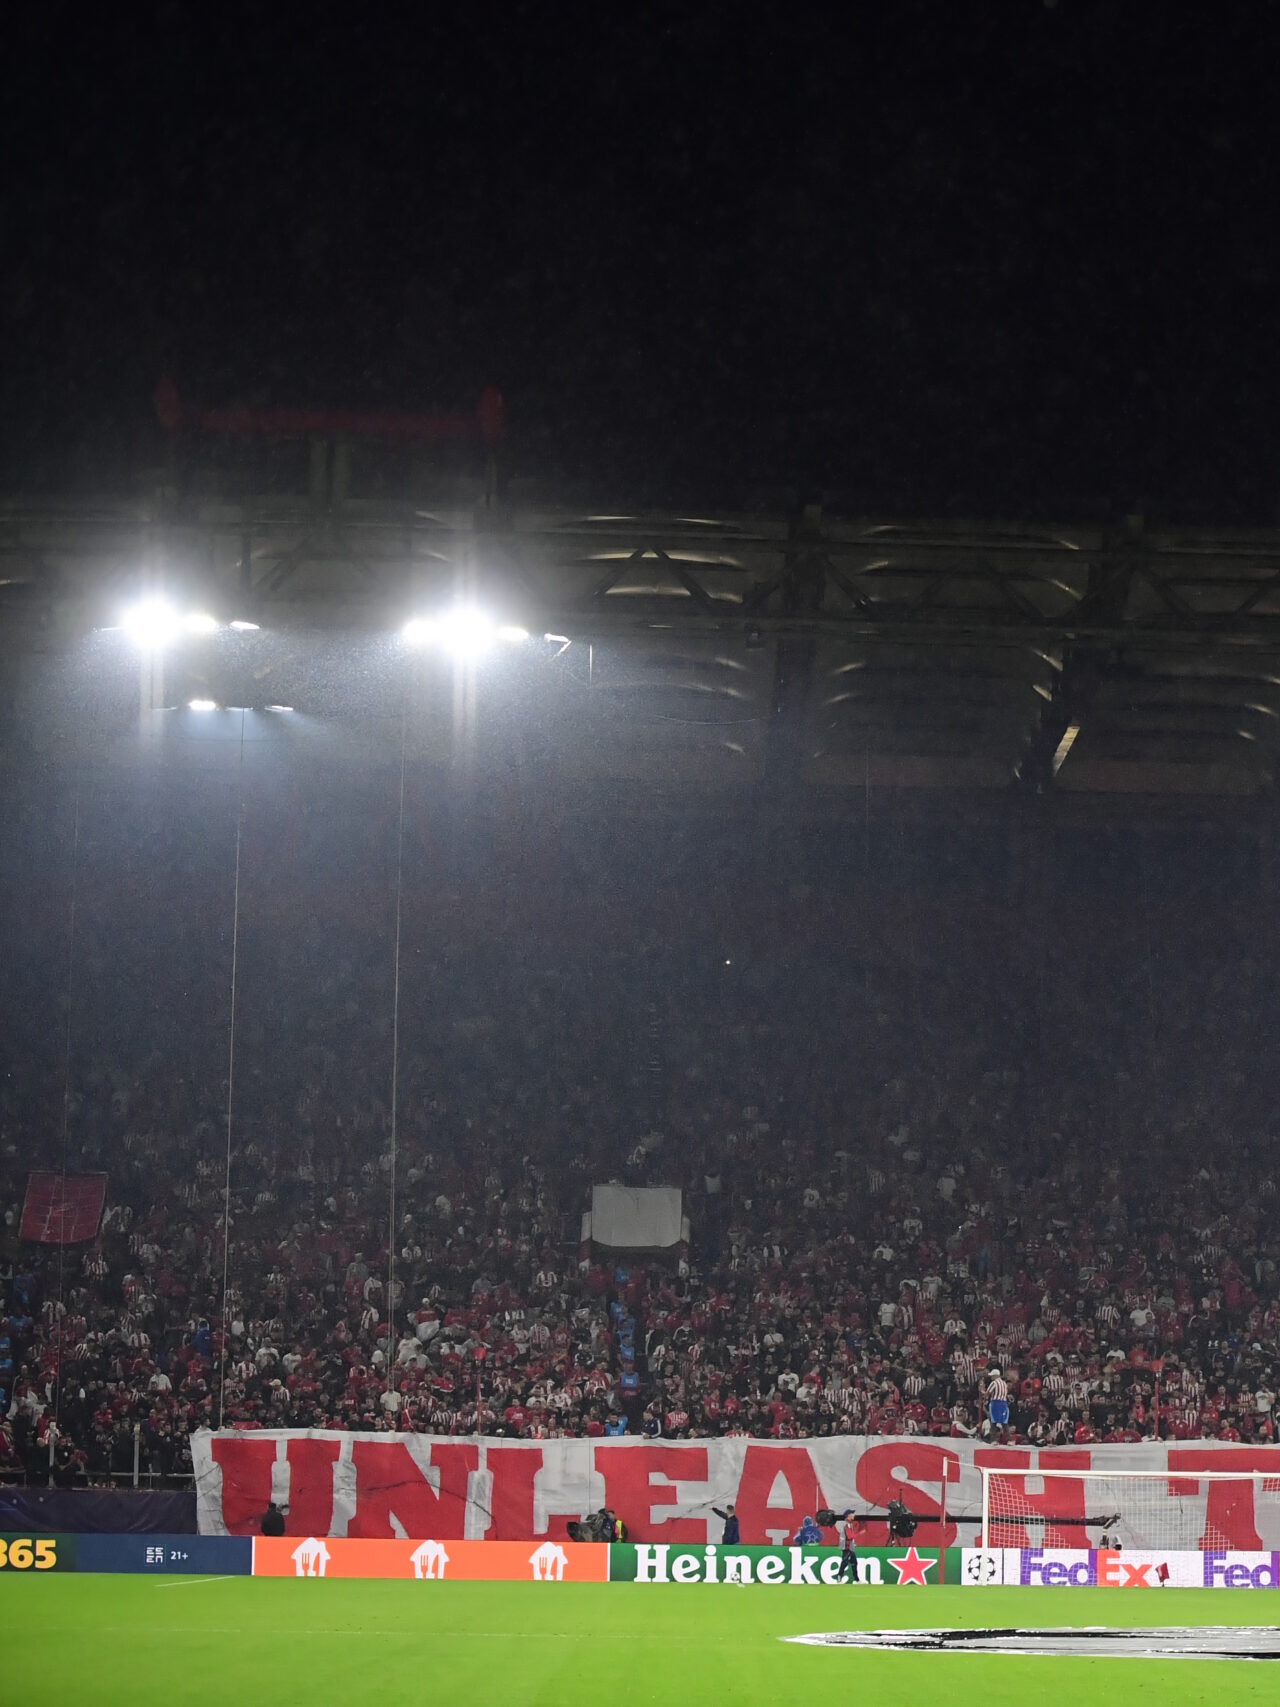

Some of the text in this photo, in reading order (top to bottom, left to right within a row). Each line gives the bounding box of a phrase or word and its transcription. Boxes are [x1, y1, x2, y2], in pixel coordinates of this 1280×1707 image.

[211, 1437, 1092, 1549] UNLEASH
[170, 1551, 188, 1560] 21+
[633, 1544, 884, 1585] Heineken
[1020, 1547, 1153, 1587] FedEx
